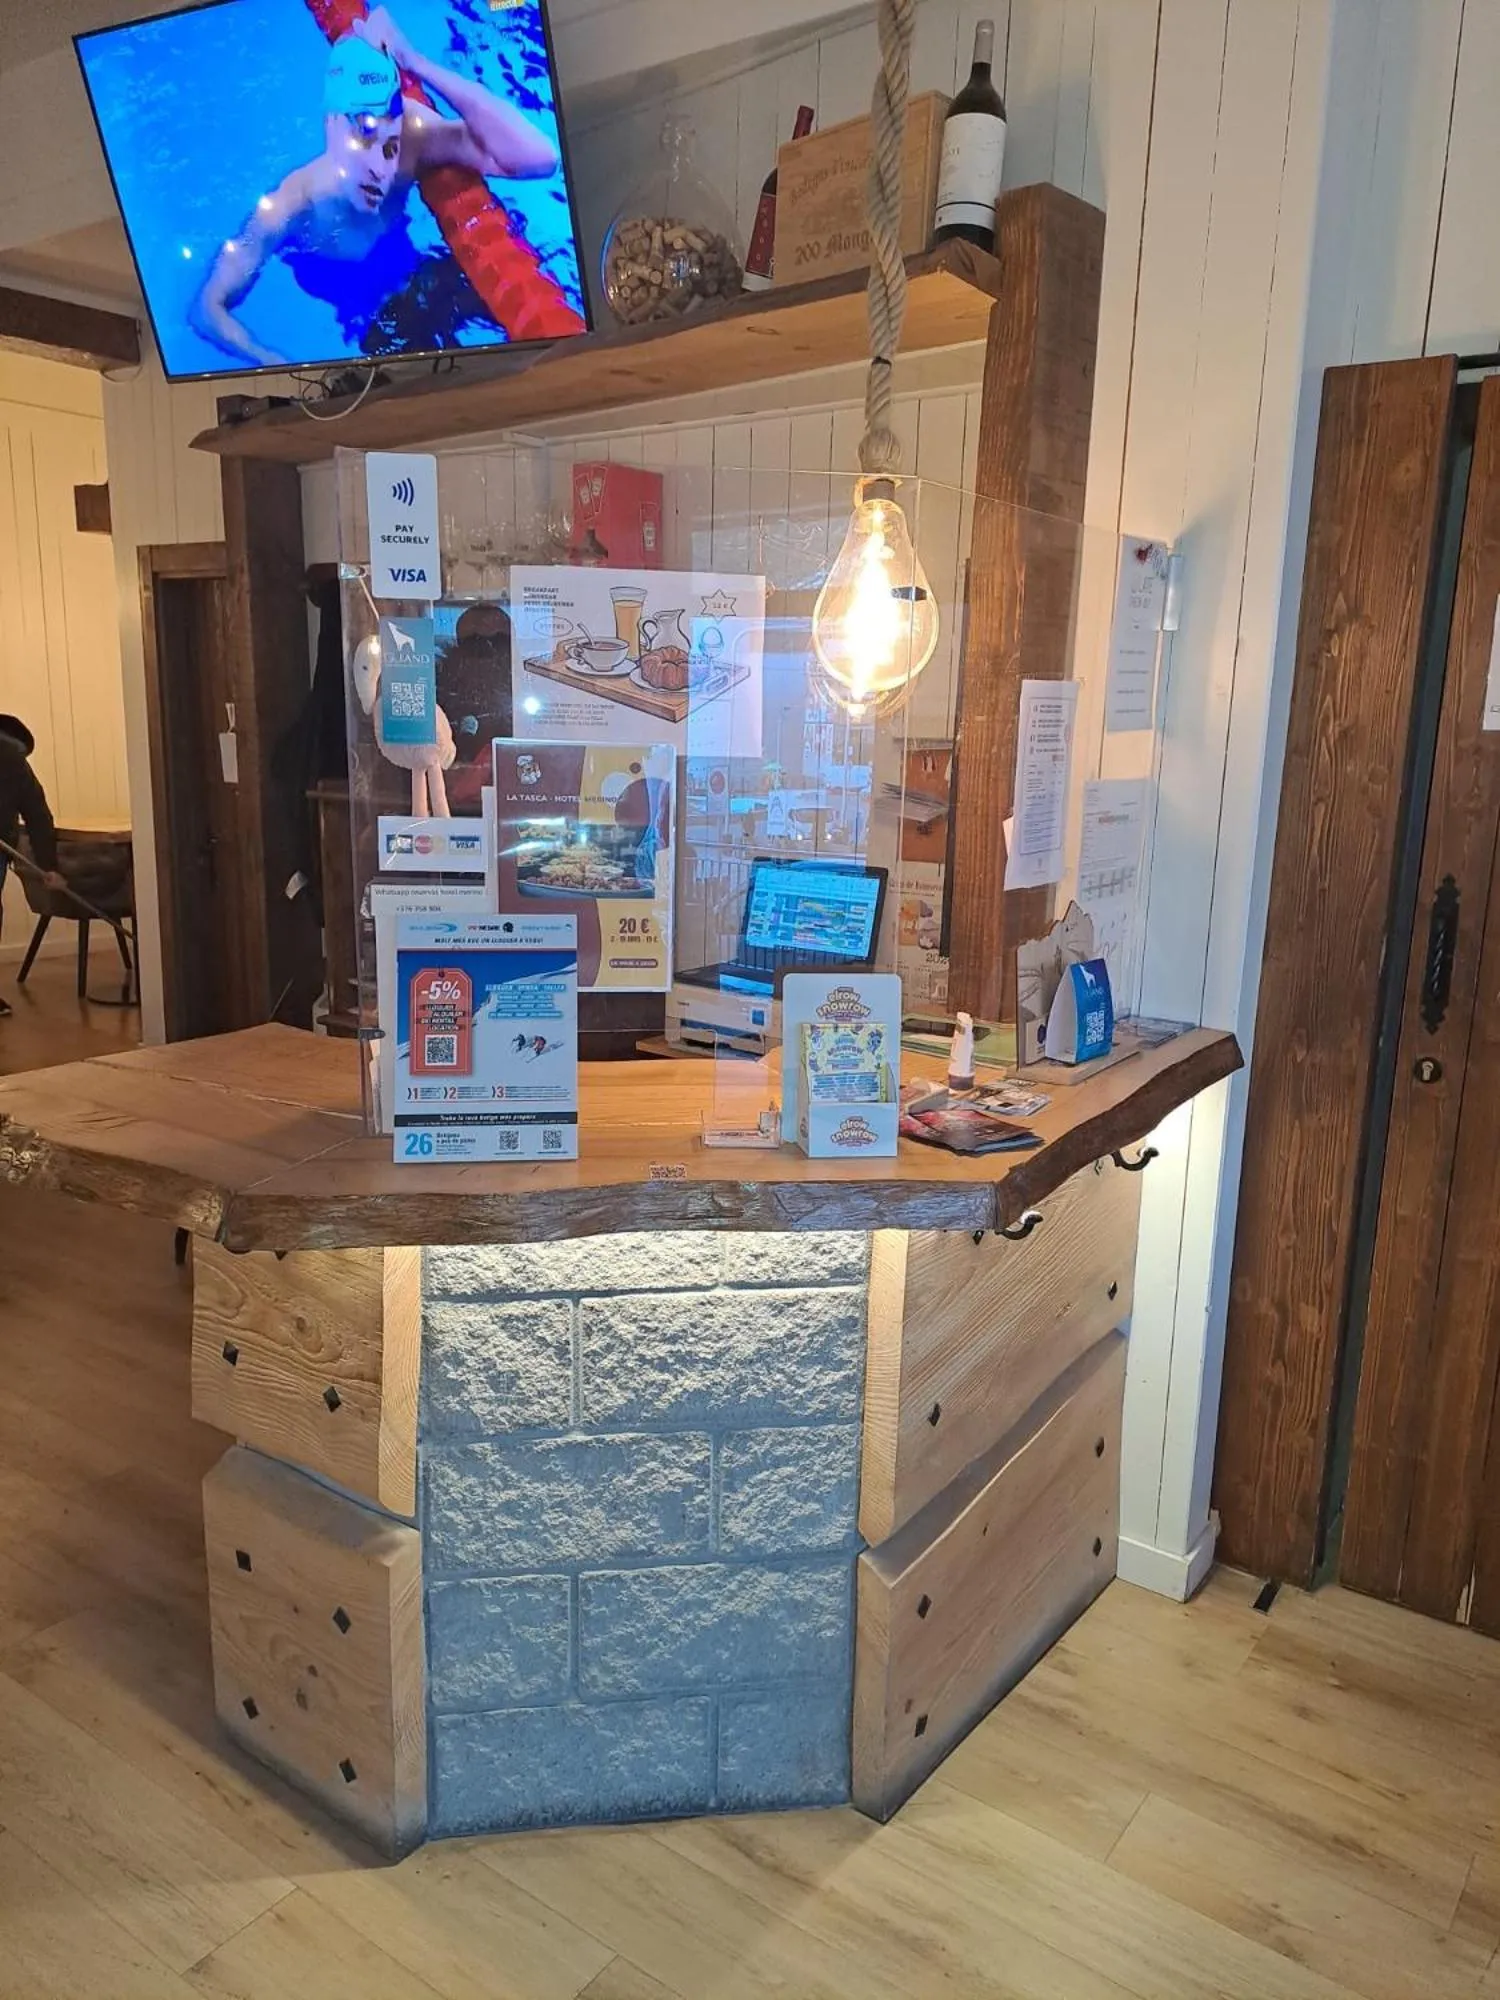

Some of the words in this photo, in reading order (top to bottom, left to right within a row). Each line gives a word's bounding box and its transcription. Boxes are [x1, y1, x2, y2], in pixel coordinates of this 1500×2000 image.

[395, 524, 414, 533] PAY
[380, 535, 430, 544] SECURELY
[388, 567, 427, 583] VISA
[506, 793, 518, 801] LA
[520, 794, 547, 802] TASCA
[554, 795, 581, 803] HOTEL
[619, 918, 636, 934] 20
[641, 918, 650, 934] €
[420, 980, 461, 1000] -5%
[828, 990, 860, 1003] elrow
[817, 1001, 871, 1017] snowrow
[413, 1088, 418, 1099] 1
[449, 1087, 456, 1099] 2
[497, 1087, 504, 1098] 3
[840, 1120, 867, 1130] elrow
[831, 1129, 877, 1142] snowrow
[405, 1132, 433, 1155] 26
